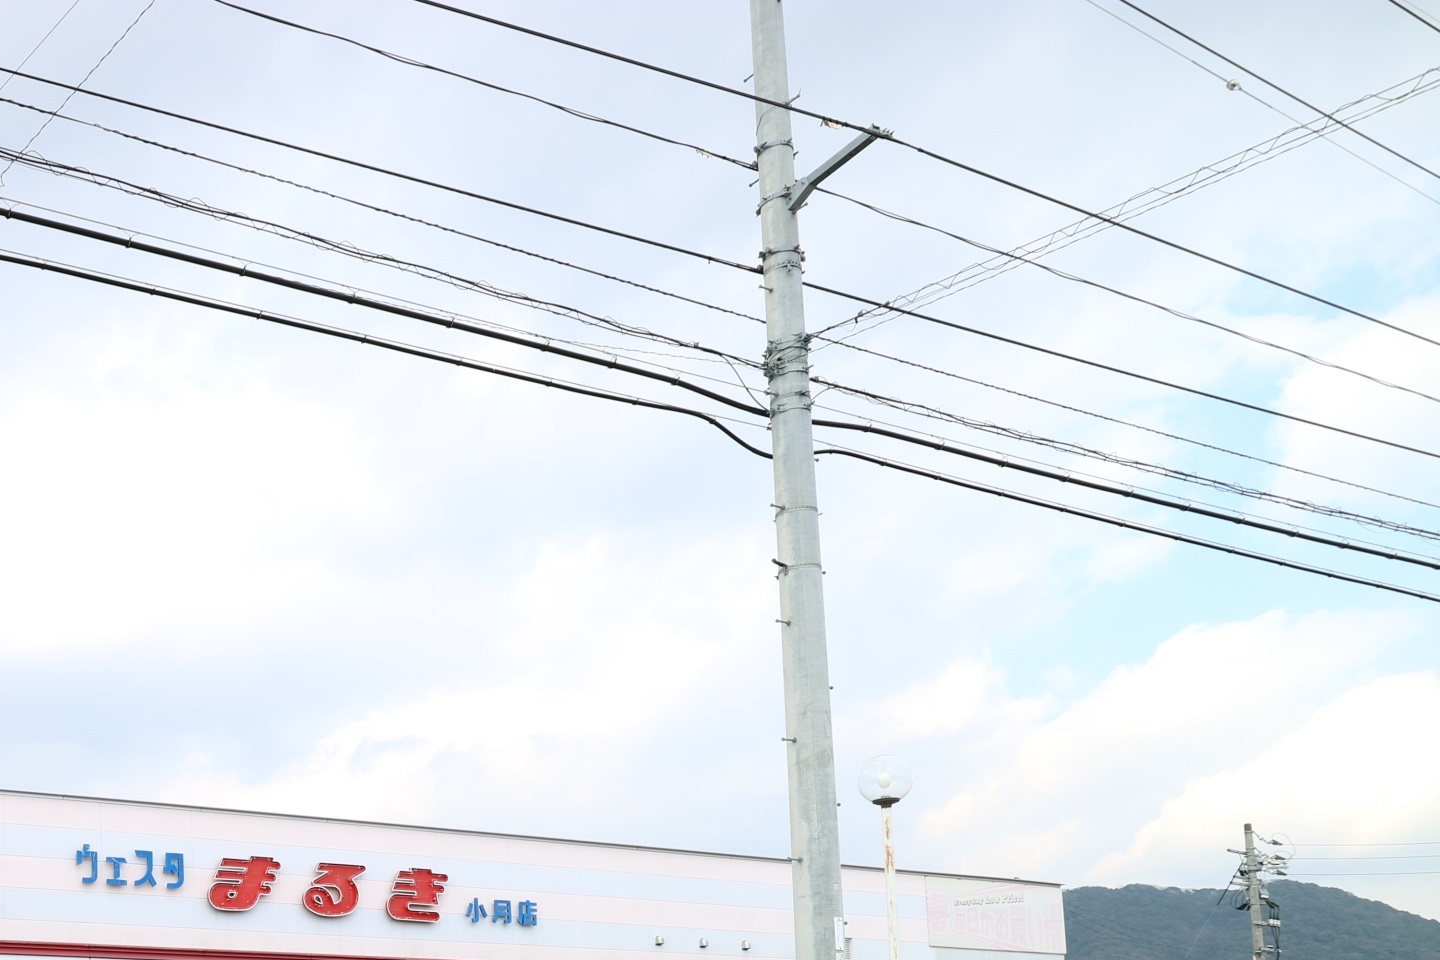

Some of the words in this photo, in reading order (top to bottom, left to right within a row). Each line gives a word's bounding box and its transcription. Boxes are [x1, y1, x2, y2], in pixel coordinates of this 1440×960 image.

[75, 843, 184, 889] ウェスタ
[207, 856, 449, 923] まるき
[465, 898, 538, 927] 小月店
